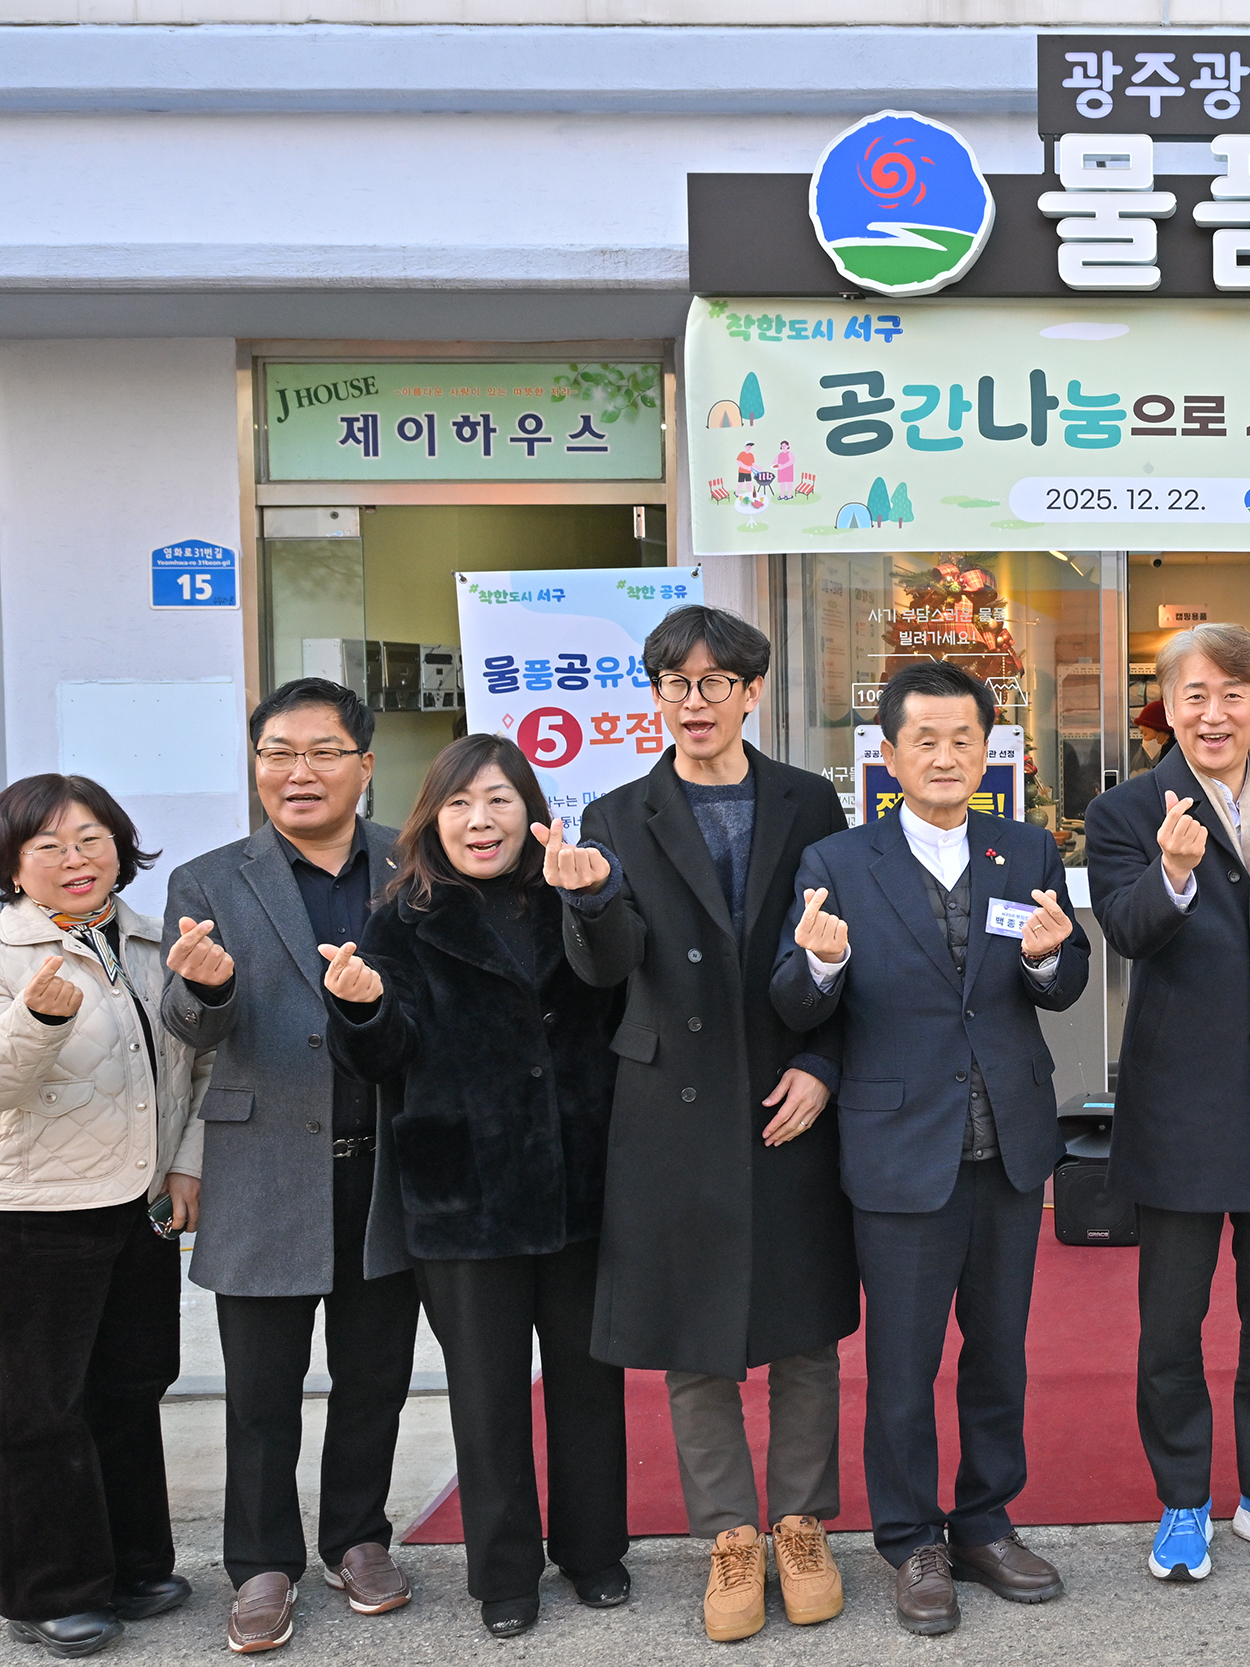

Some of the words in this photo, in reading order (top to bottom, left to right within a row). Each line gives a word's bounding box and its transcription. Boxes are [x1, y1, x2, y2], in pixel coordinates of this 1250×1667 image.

[843, 314, 904, 343] 서구
[295, 376, 380, 409] HOUSE
[450, 387, 481, 397] 사랑이
[487, 387, 507, 397] 있는
[513, 387, 545, 397] 따뜻한
[816, 368, 1228, 457] 공간나눔으로
[339, 412, 609, 459] 제이하우스
[1045, 488, 1118, 511] 2025.
[1126, 488, 1159, 511] 12.
[1167, 488, 1206, 511] 22.
[177, 574, 213, 600] 15
[537, 588, 567, 603] 서구
[659, 584, 688, 600] 공유
[868, 608, 897, 624] 사기
[902, 607, 973, 624] 부담스러운
[978, 607, 1007, 623] 물품
[899, 630, 976, 646] 빌려가세요!
[534, 715, 568, 762] 5
[864, 750, 884, 758] 공공
[999, 750, 1015, 758] 선정
[582, 791, 607, 805] 마
